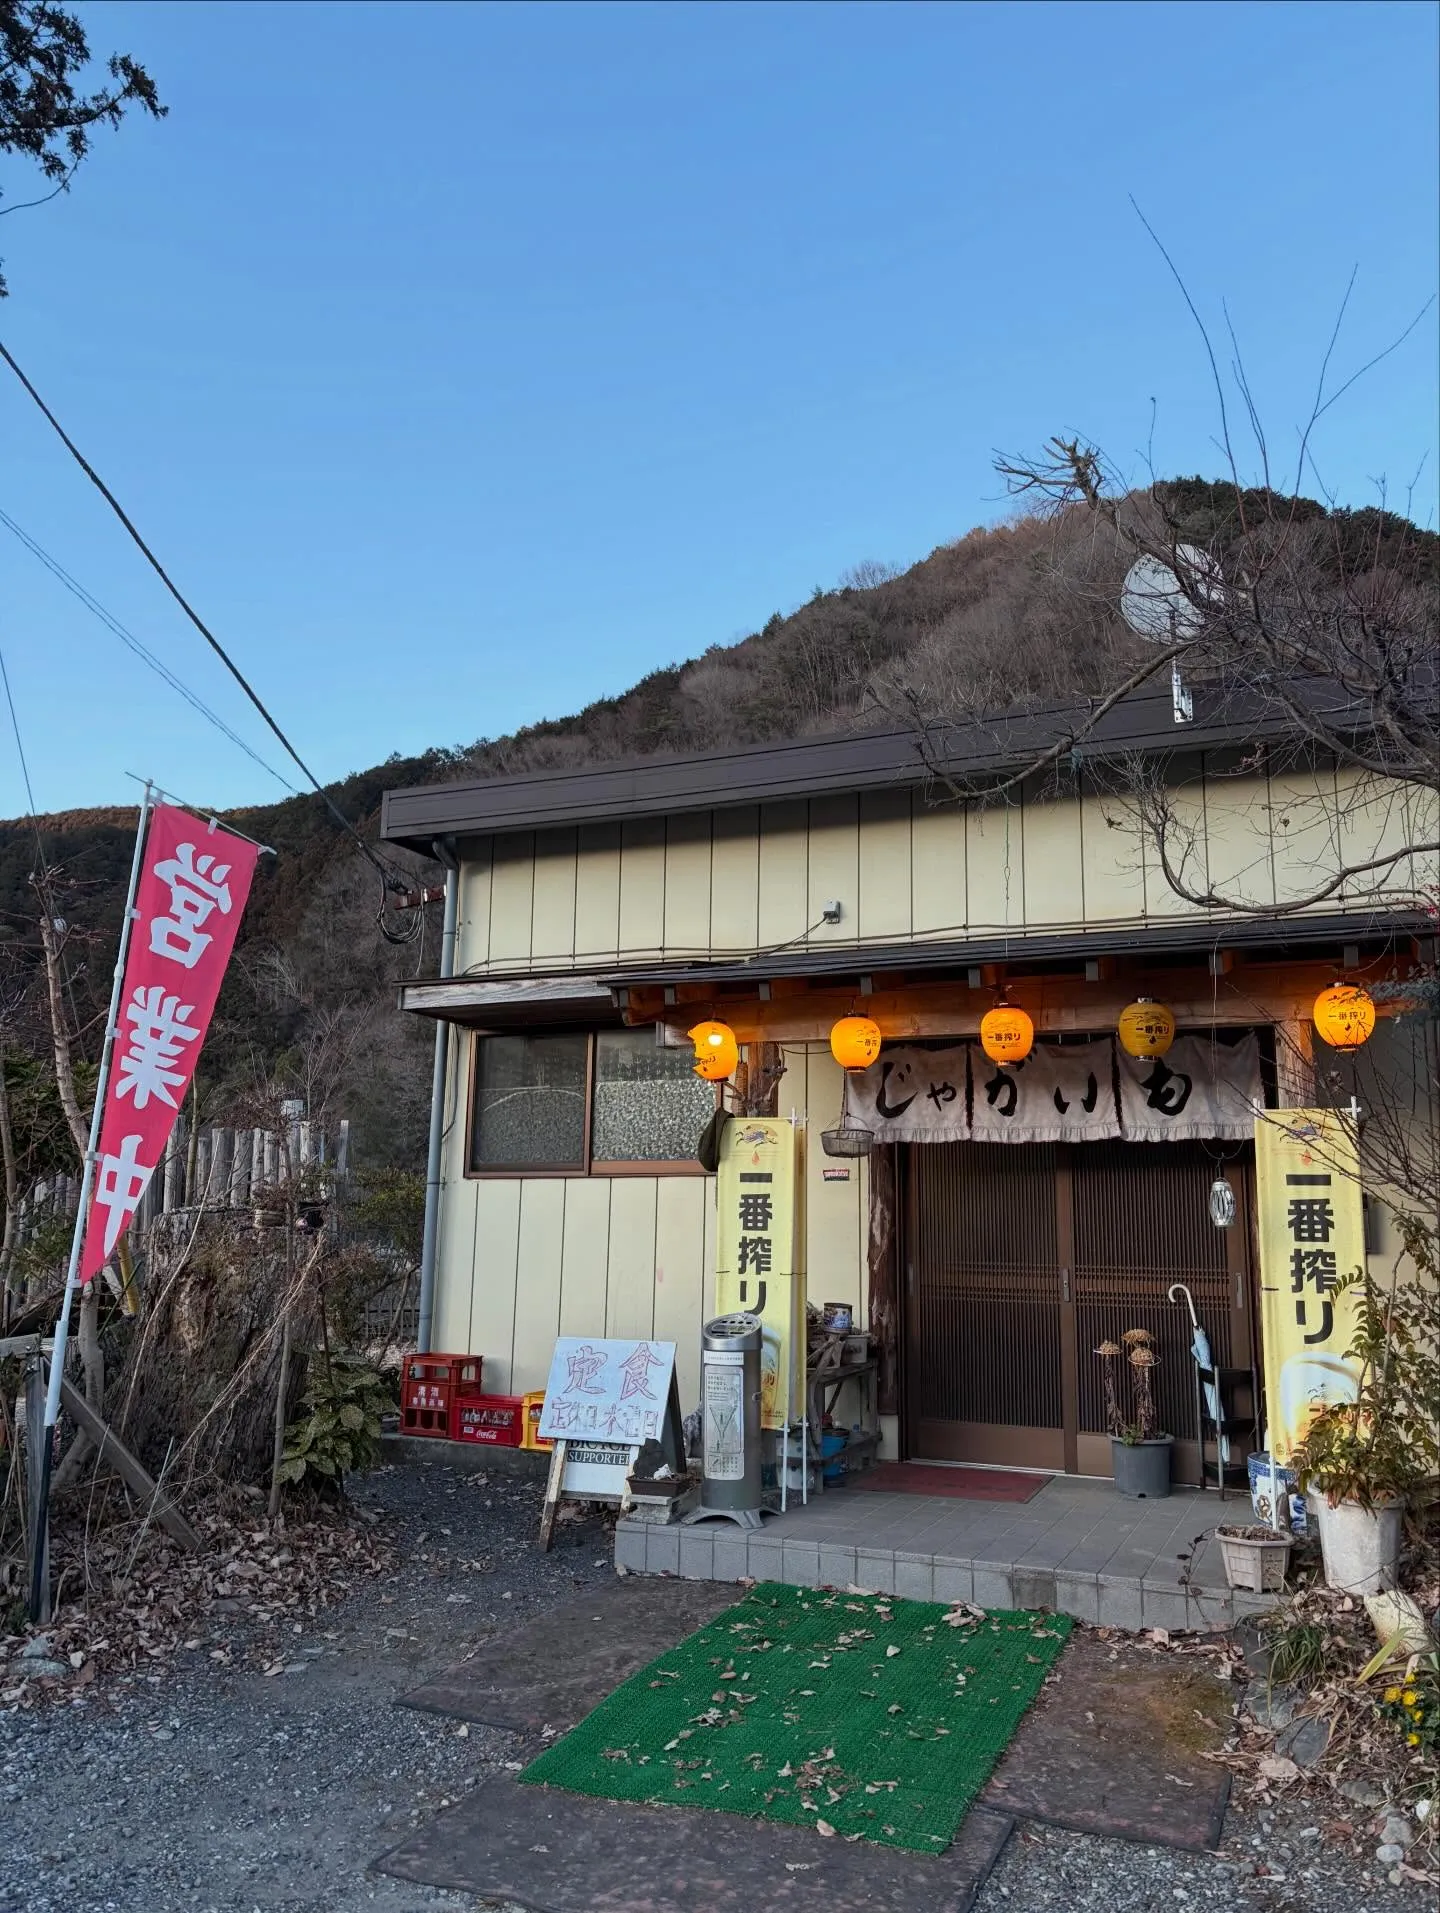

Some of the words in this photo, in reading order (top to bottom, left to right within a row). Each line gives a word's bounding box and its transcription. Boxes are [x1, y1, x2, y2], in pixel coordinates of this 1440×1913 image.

[96, 842, 232, 1257] 営業中
[987, 1032, 1021, 1042] 一番搾り
[738, 1172, 773, 1315] 一番搾り
[1286, 1174, 1336, 1345] 一番搾り
[562, 1342, 665, 1400] 定食
